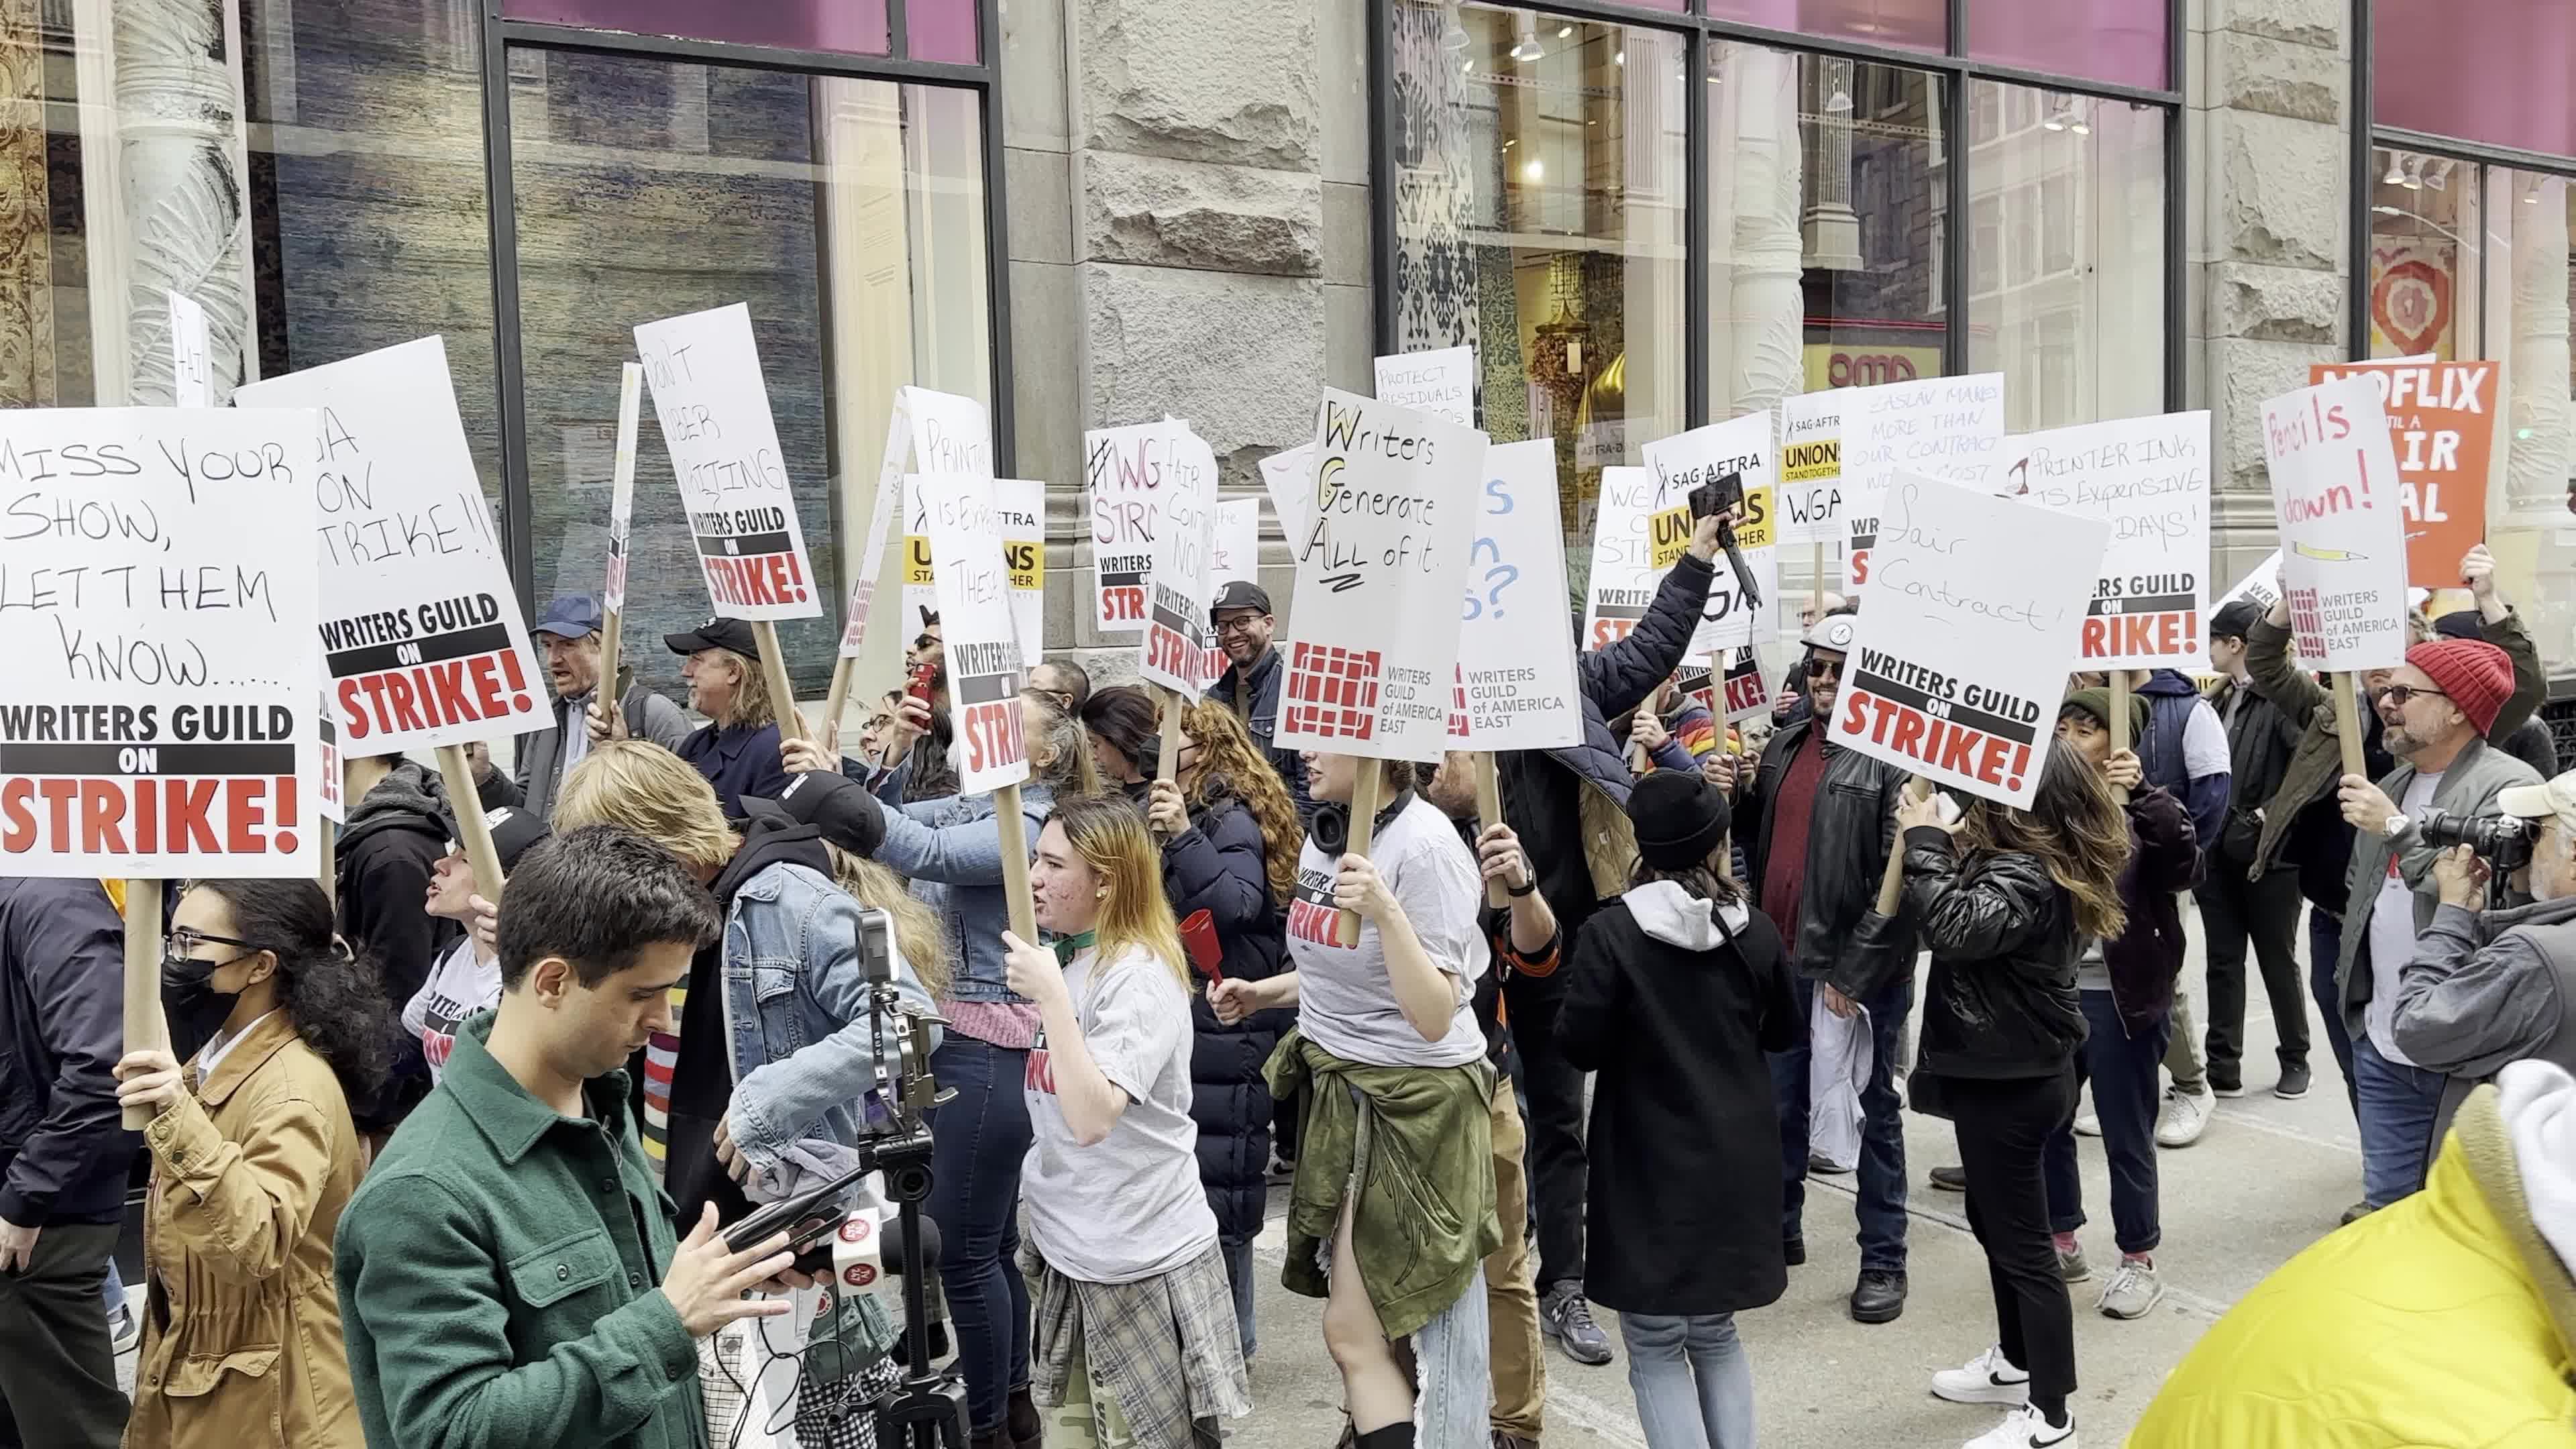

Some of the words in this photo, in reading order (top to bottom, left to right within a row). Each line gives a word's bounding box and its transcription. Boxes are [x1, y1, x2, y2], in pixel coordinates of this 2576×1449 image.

[1326, 400, 1435, 465] Writers
[1870, 419, 1917, 441] MORE
[2409, 415, 2421, 429] A
[1088, 437, 1160, 496] #WG
[1786, 443, 1840, 468] UNION
[1853, 445, 1898, 467] OUR
[2031, 442, 2131, 478] PRINTER
[2136, 434, 2196, 463] INK
[158, 437, 292, 504] YOUR
[317, 461, 372, 513] ON
[1318, 457, 1434, 513] Generate
[5, 492, 170, 551] SHOW,
[317, 492, 492, 566] TRIKE!!
[690, 511, 733, 536] WRITERS
[735, 506, 785, 534] GUILD
[724, 538, 741, 556] ON
[1383, 535, 1412, 566] of
[1099, 555, 1152, 572] WRITERS
[704, 552, 807, 606] STRIKE!
[2129, 573, 2195, 595] GUILD
[2100, 599, 2123, 614] ON
[2321, 590, 2379, 607] WRITERS
[319, 606, 413, 652] WRITERS
[417, 592, 499, 635] GUILD
[2324, 606, 2363, 622] GUILD
[2326, 624, 2338, 636] of
[2343, 618, 2400, 635] AMERICA
[396, 642, 423, 666] ON
[2328, 636, 2361, 650] EAST
[1388, 665, 1432, 686] WRITERS
[1468, 667, 1536, 684] WRITERS
[1862, 647, 1958, 700] WRITERS
[1963, 683, 2040, 724] GUILD
[337, 648, 533, 739] STRIKE!
[1385, 683, 1415, 701] GUILD
[1470, 684, 1517, 700] GUILD
[1382, 703, 1395, 716] of
[1395, 706, 1443, 722] AMERICA
[1472, 702, 1487, 715] of
[1491, 696, 1565, 714] AMERICA
[1925, 697, 1953, 719] ON
[1, 704, 158, 741] WRITERS
[172, 704, 293, 741] GUILD
[1380, 718, 1406, 735] EAST
[1475, 715, 1513, 730] EAST
[1841, 690, 2033, 792] STRIKE!
[118, 747, 158, 773] ON
[2, 777, 299, 855] STRIKE!
